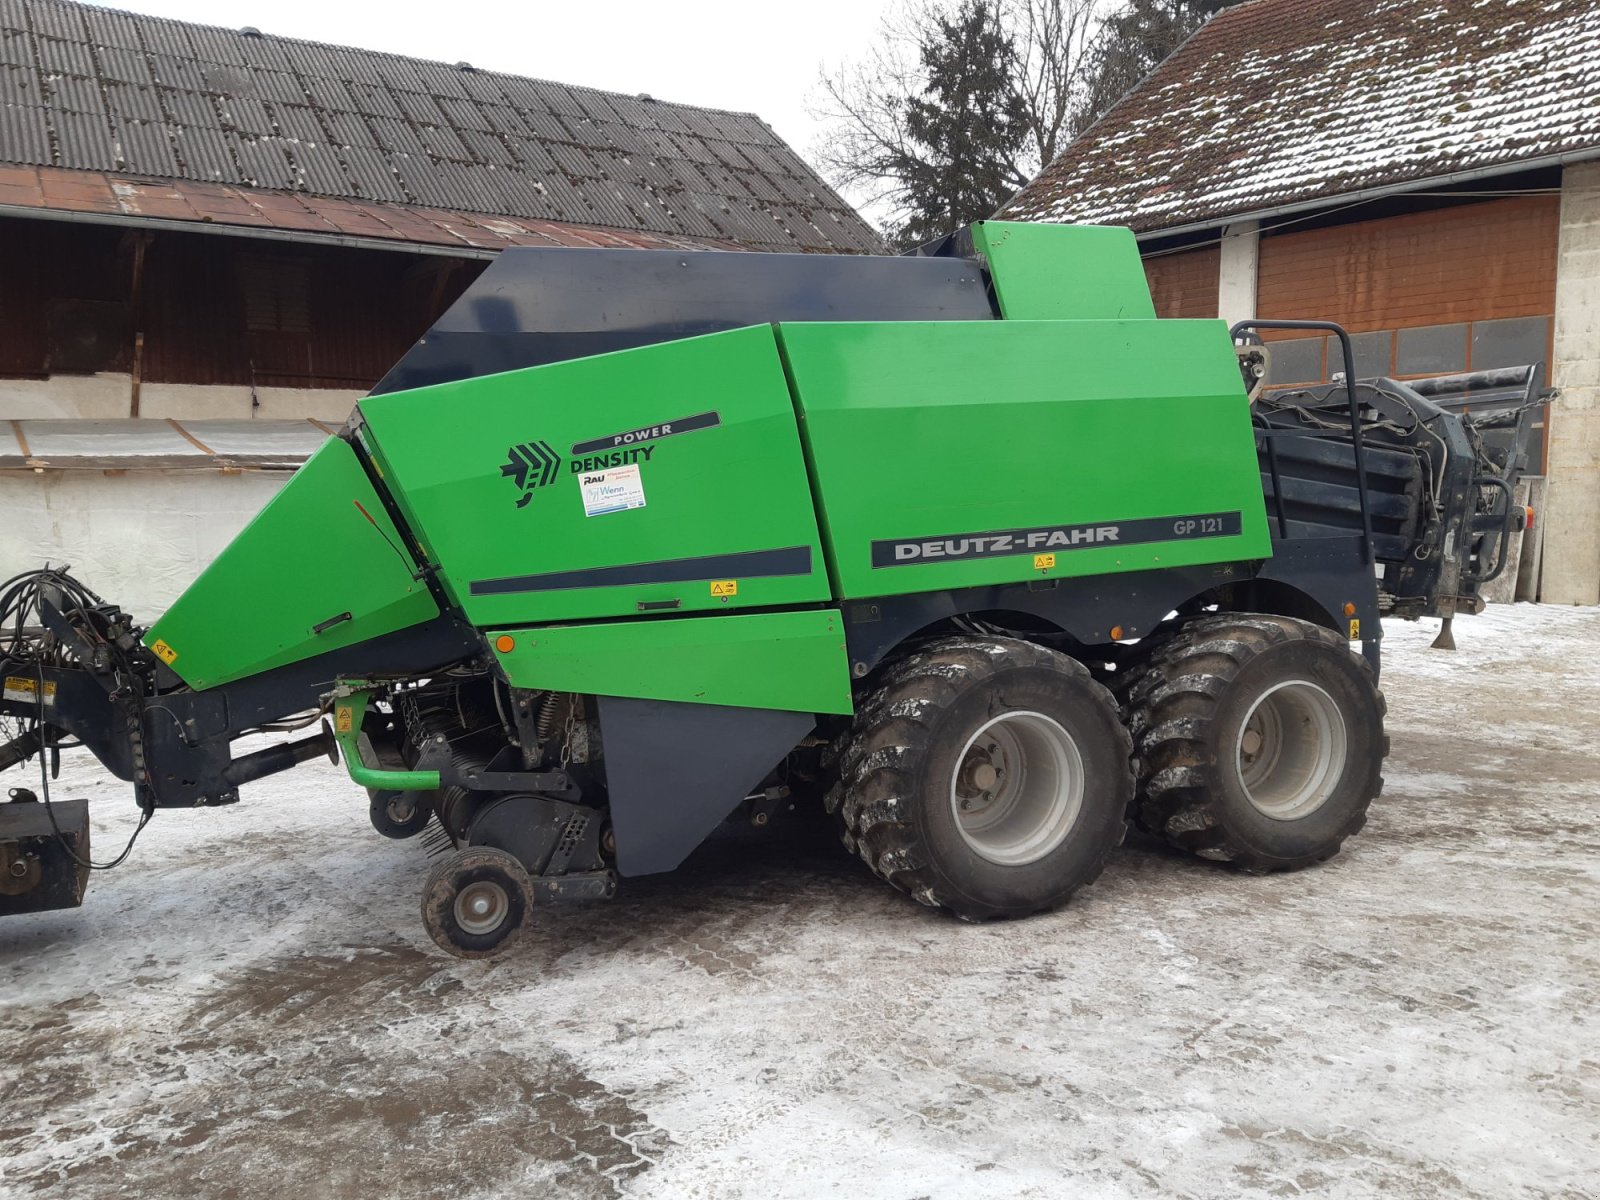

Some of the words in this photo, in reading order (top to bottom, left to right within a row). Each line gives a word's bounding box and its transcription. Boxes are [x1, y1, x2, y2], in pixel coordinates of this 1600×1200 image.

[614, 424, 672, 446] POWER
[570, 445, 655, 474] DENSITY
[583, 474, 606, 486] RAU
[895, 526, 1120, 560] DEUTZ-FAHR
[1173, 519, 1196, 535] GP
[1200, 517, 1223, 533] 121
